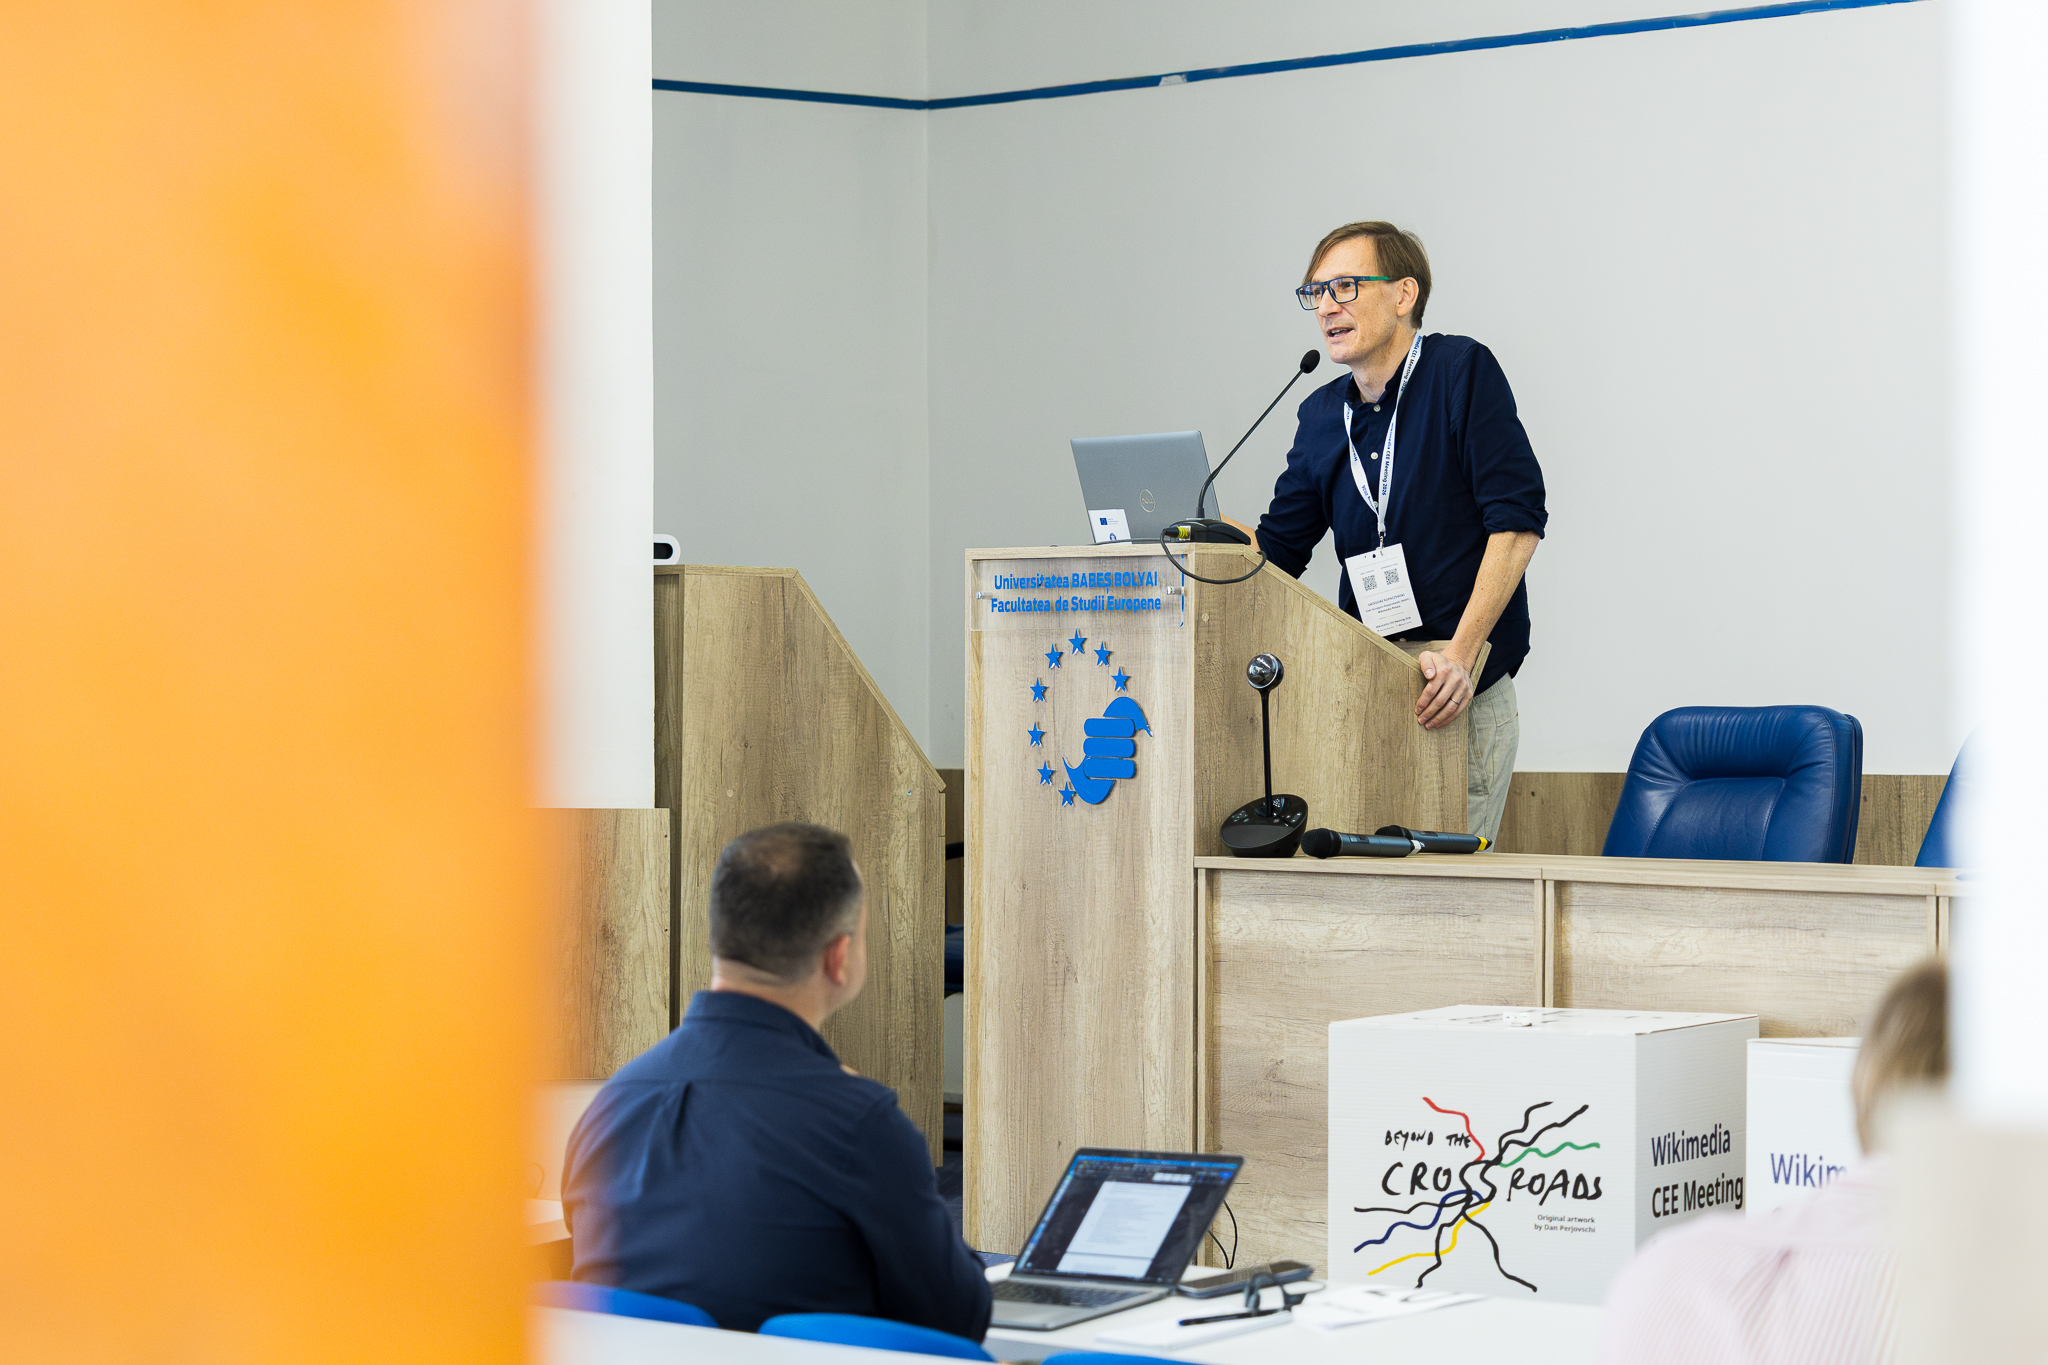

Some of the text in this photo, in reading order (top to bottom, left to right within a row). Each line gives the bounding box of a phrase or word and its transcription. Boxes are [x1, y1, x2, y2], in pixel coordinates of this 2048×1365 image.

[1382, 461, 1390, 482] Meeting
[994, 573, 1070, 590] Universitatea
[1114, 571, 1158, 587] BOLYAI
[991, 595, 1161, 614] Facultatea de Studii Europene
[1384, 1130, 1471, 1151] BEYOND THE
[1651, 1123, 1731, 1167] Wikimedia
[1770, 1153, 1847, 1189] Wikim
[1652, 1172, 1743, 1218] CEE Meeting
[1534, 1223, 1542, 1231] by
[1560, 1225, 1596, 1233] Perjovschi
[1537, 1214, 1566, 1223] Original
